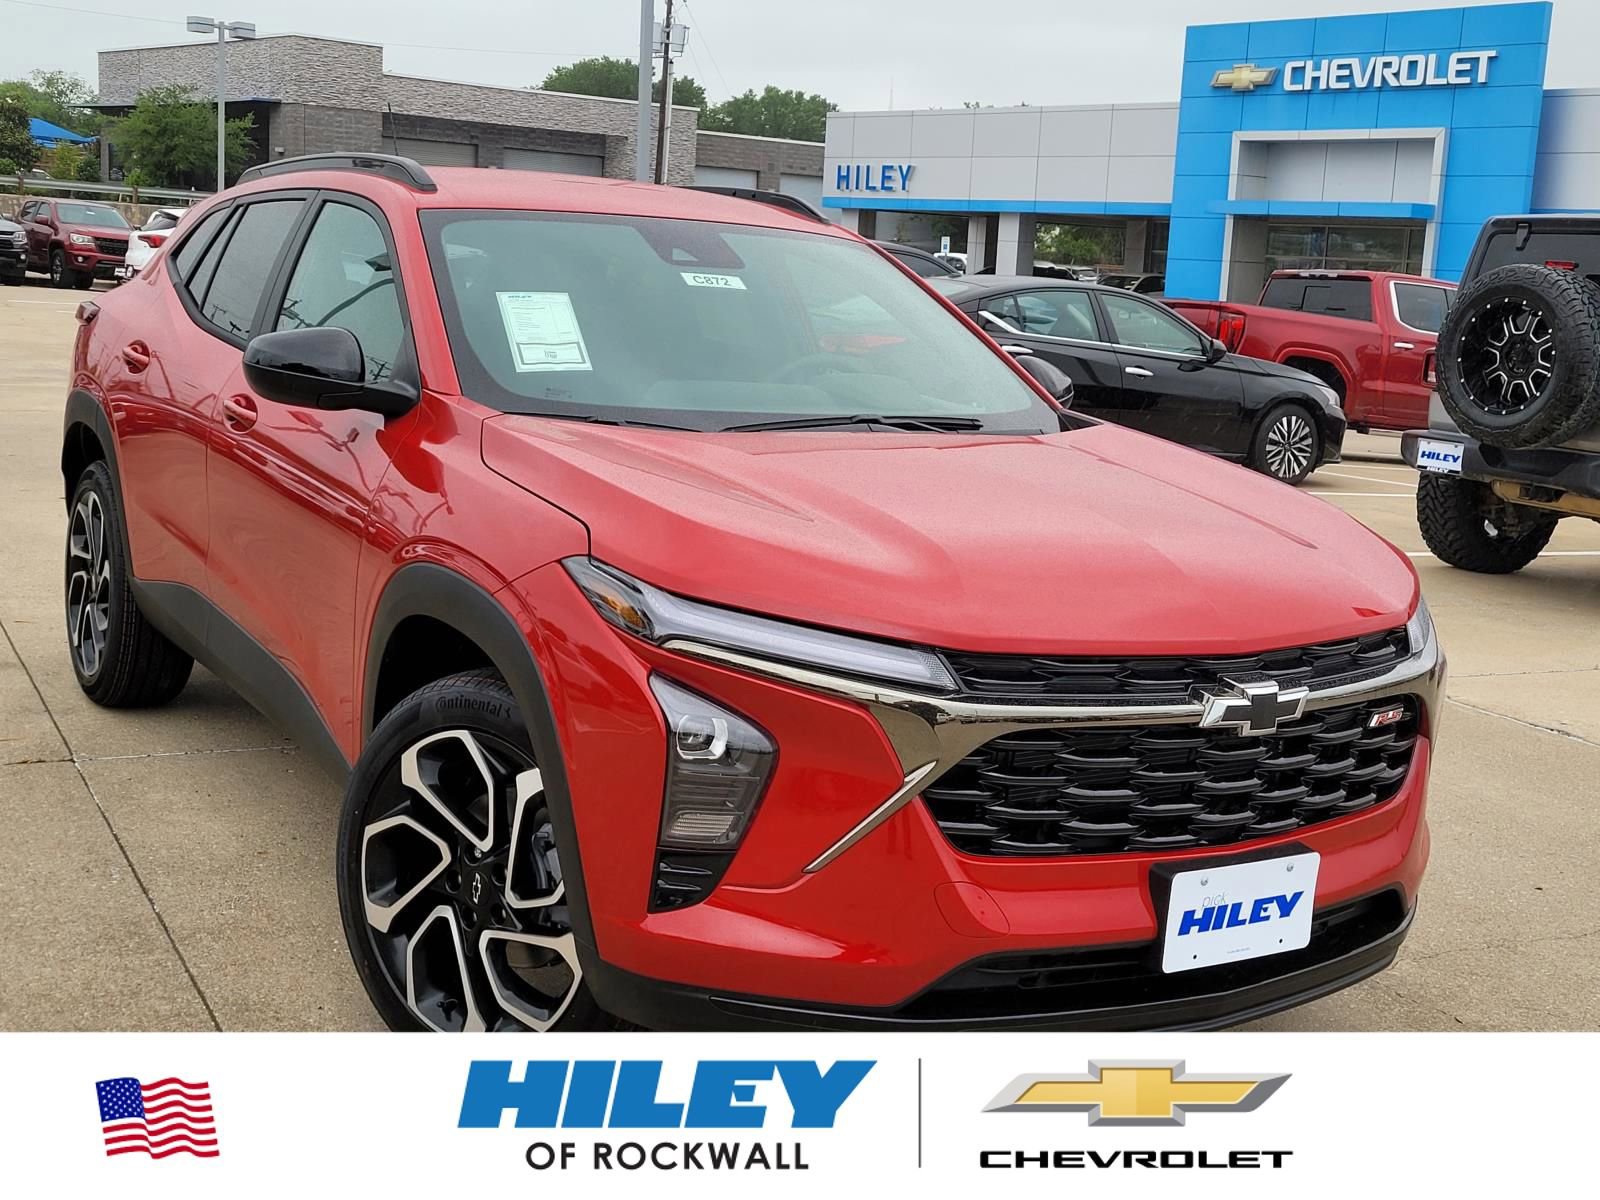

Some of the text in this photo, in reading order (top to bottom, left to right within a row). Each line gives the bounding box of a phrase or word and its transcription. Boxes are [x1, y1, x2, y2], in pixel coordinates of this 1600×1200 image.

[1283, 50, 1498, 91] CHEVROLET
[836, 164, 912, 191] HILEY
[692, 275, 733, 286] C872
[1420, 450, 1461, 463] HILEY
[435, 694, 503, 718] Continental
[1177, 890, 1305, 937] HILEY
